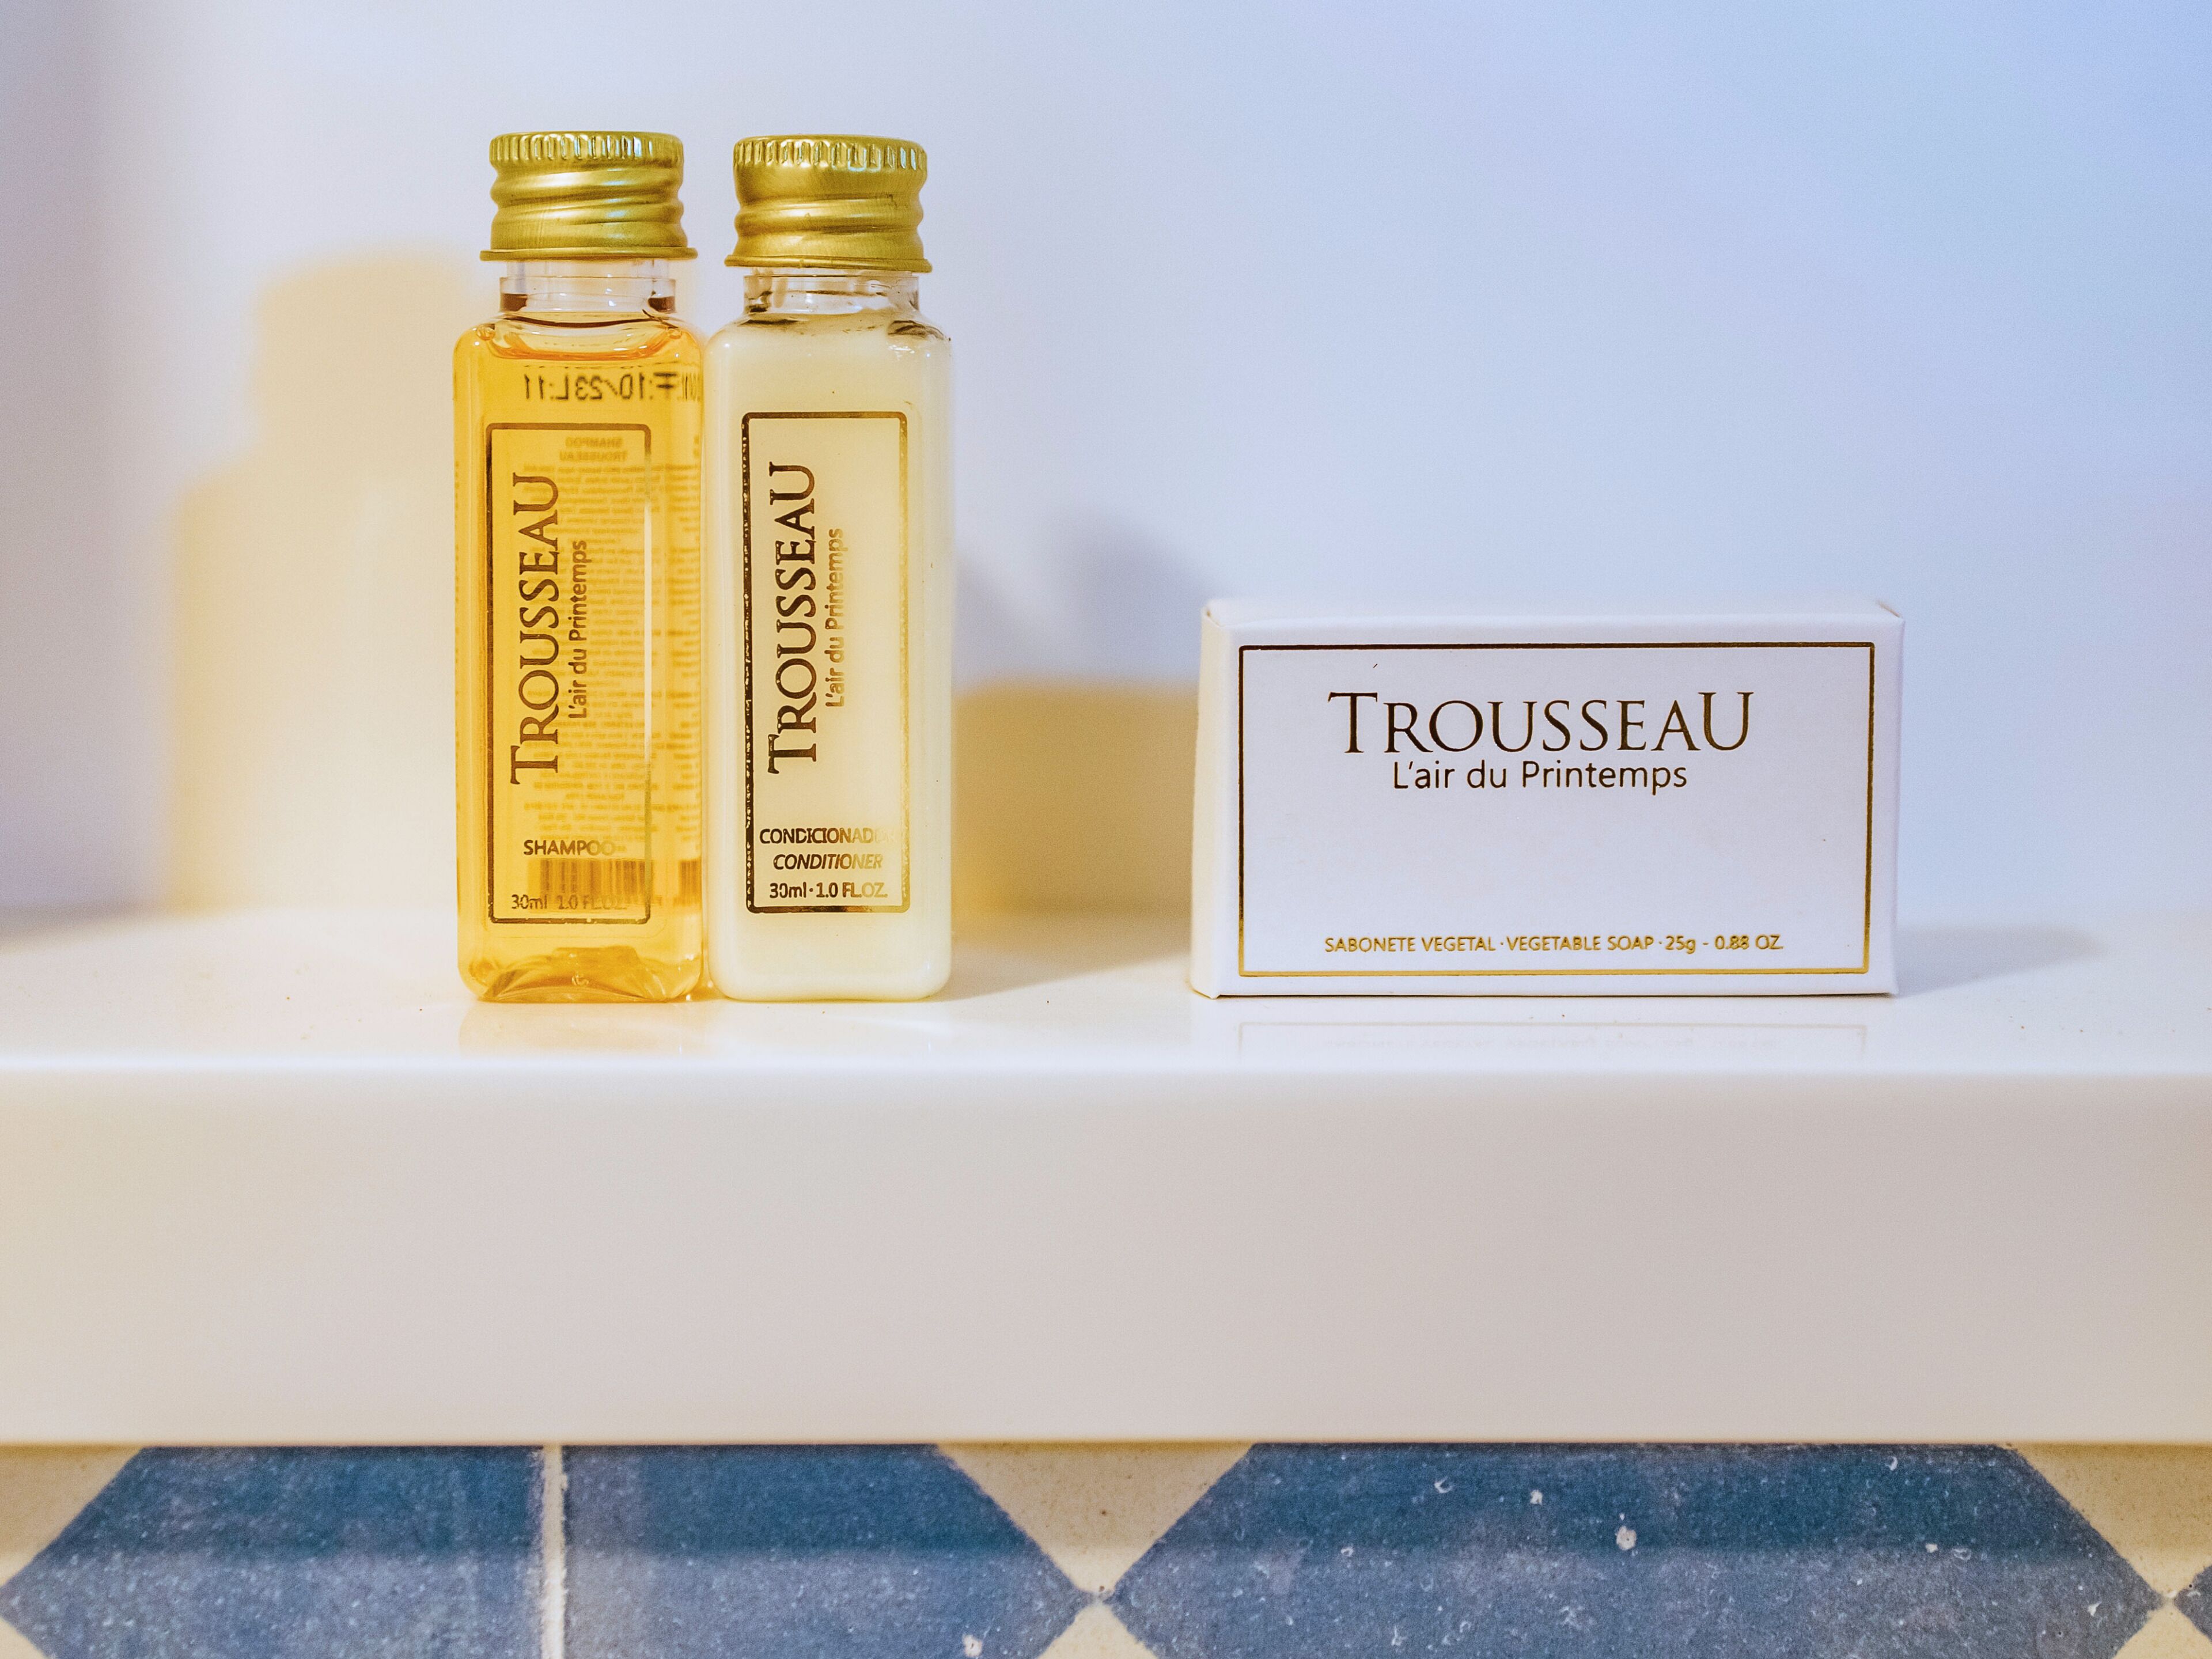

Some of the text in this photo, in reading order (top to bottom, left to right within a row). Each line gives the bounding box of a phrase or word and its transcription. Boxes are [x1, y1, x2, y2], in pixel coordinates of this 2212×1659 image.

[510, 472, 559, 785] TROUSSEAU
[568, 540, 592, 718] L'air du Printemps
[768, 461, 816, 774] TROUSSEAU
[824, 528, 848, 707] L'air du Printemps
[1327, 691, 1755, 753] TROUSSEAU
[1393, 759, 1688, 796] L'air du Printemps
[523, 839, 615, 856] SHAMPOO
[759, 827, 892, 844] CONDICIONAD
[773, 854, 884, 870] CONDITIONER
[1324, 936, 1416, 953] SABONETE
[1421, 936, 1496, 952] VEGETAL
[1506, 935, 1601, 952] VEGETABLE
[1607, 935, 1654, 951] SOAP
[1664, 935, 1696, 955] 25g
[1714, 934, 1749, 950] 0.88
